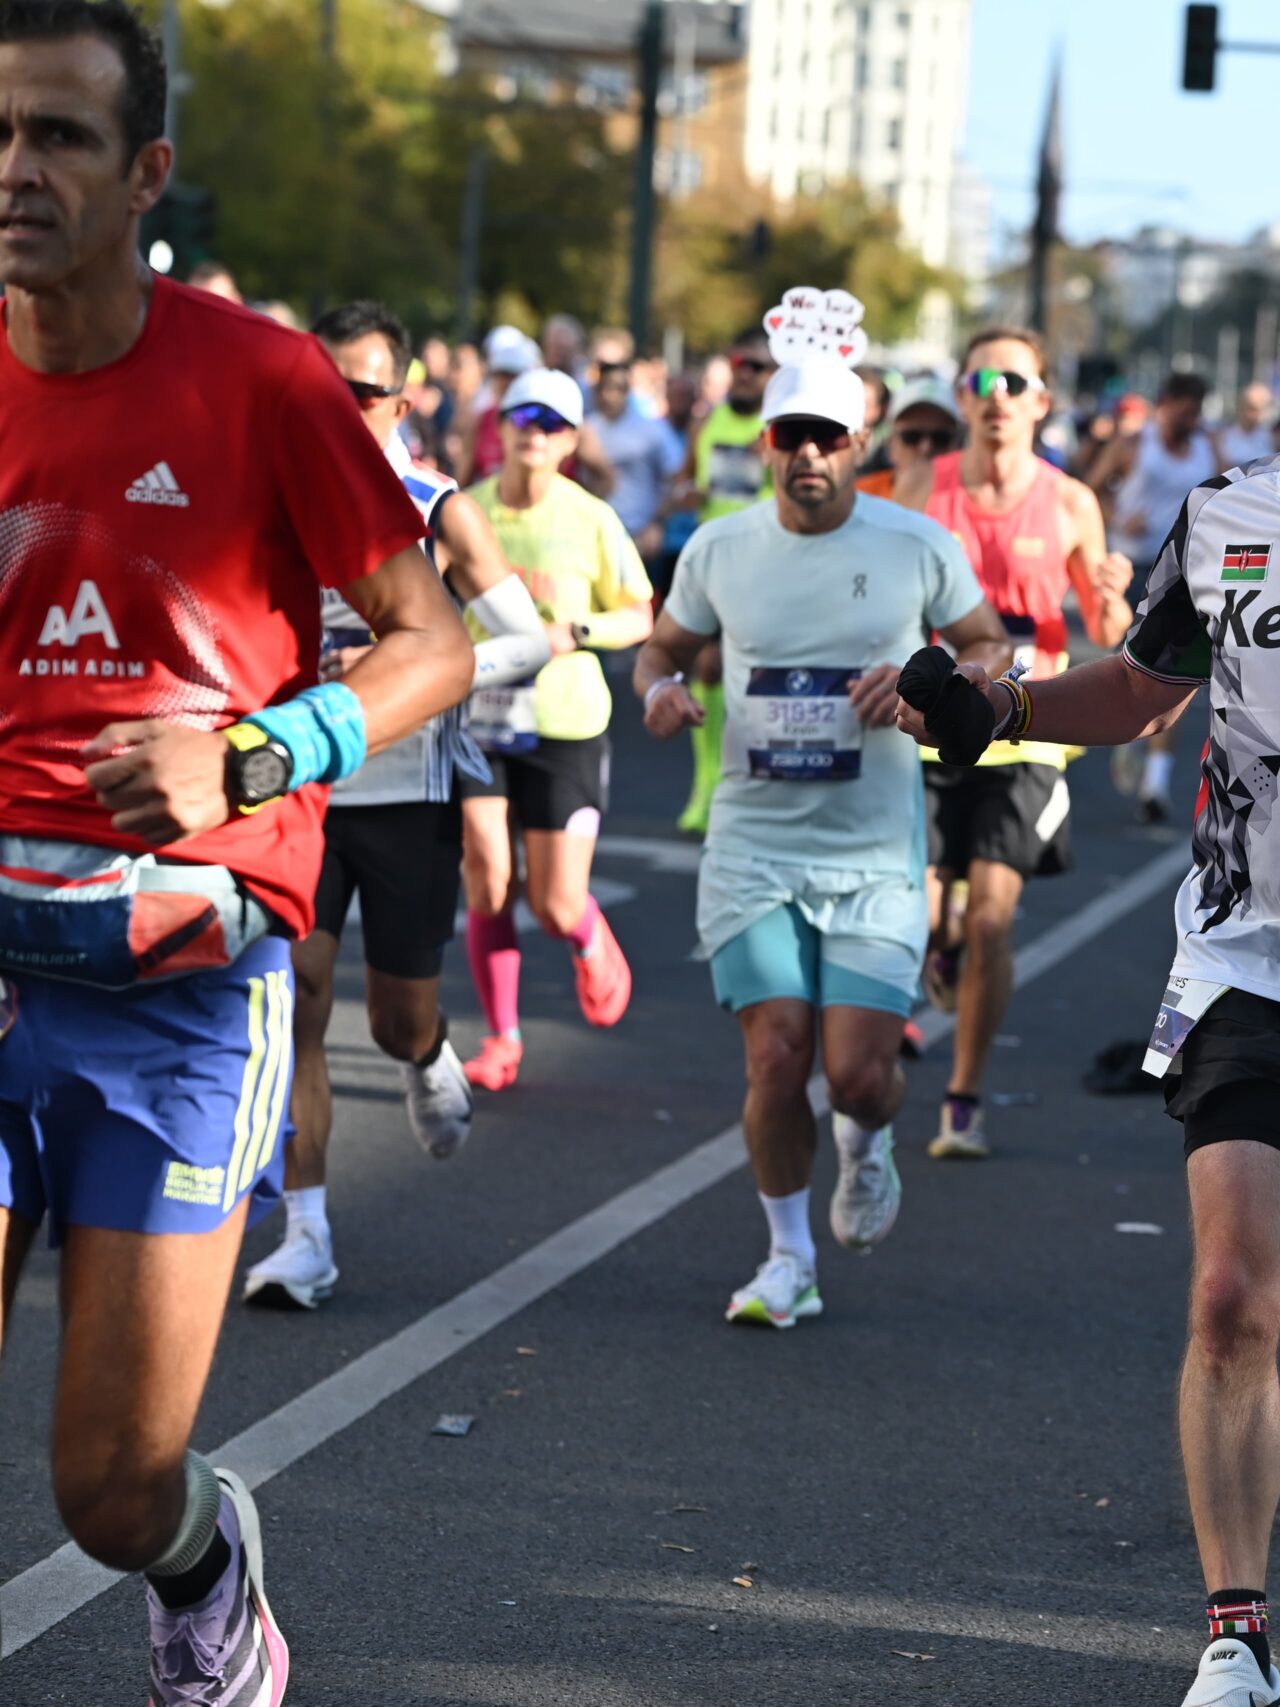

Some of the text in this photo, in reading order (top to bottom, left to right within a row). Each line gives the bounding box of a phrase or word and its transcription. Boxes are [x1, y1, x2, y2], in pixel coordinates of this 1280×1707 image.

[125, 487, 190, 508] adidas
[19, 658, 145, 678] ADIM ADIM
[1209, 1651, 1239, 1663] NIKE
